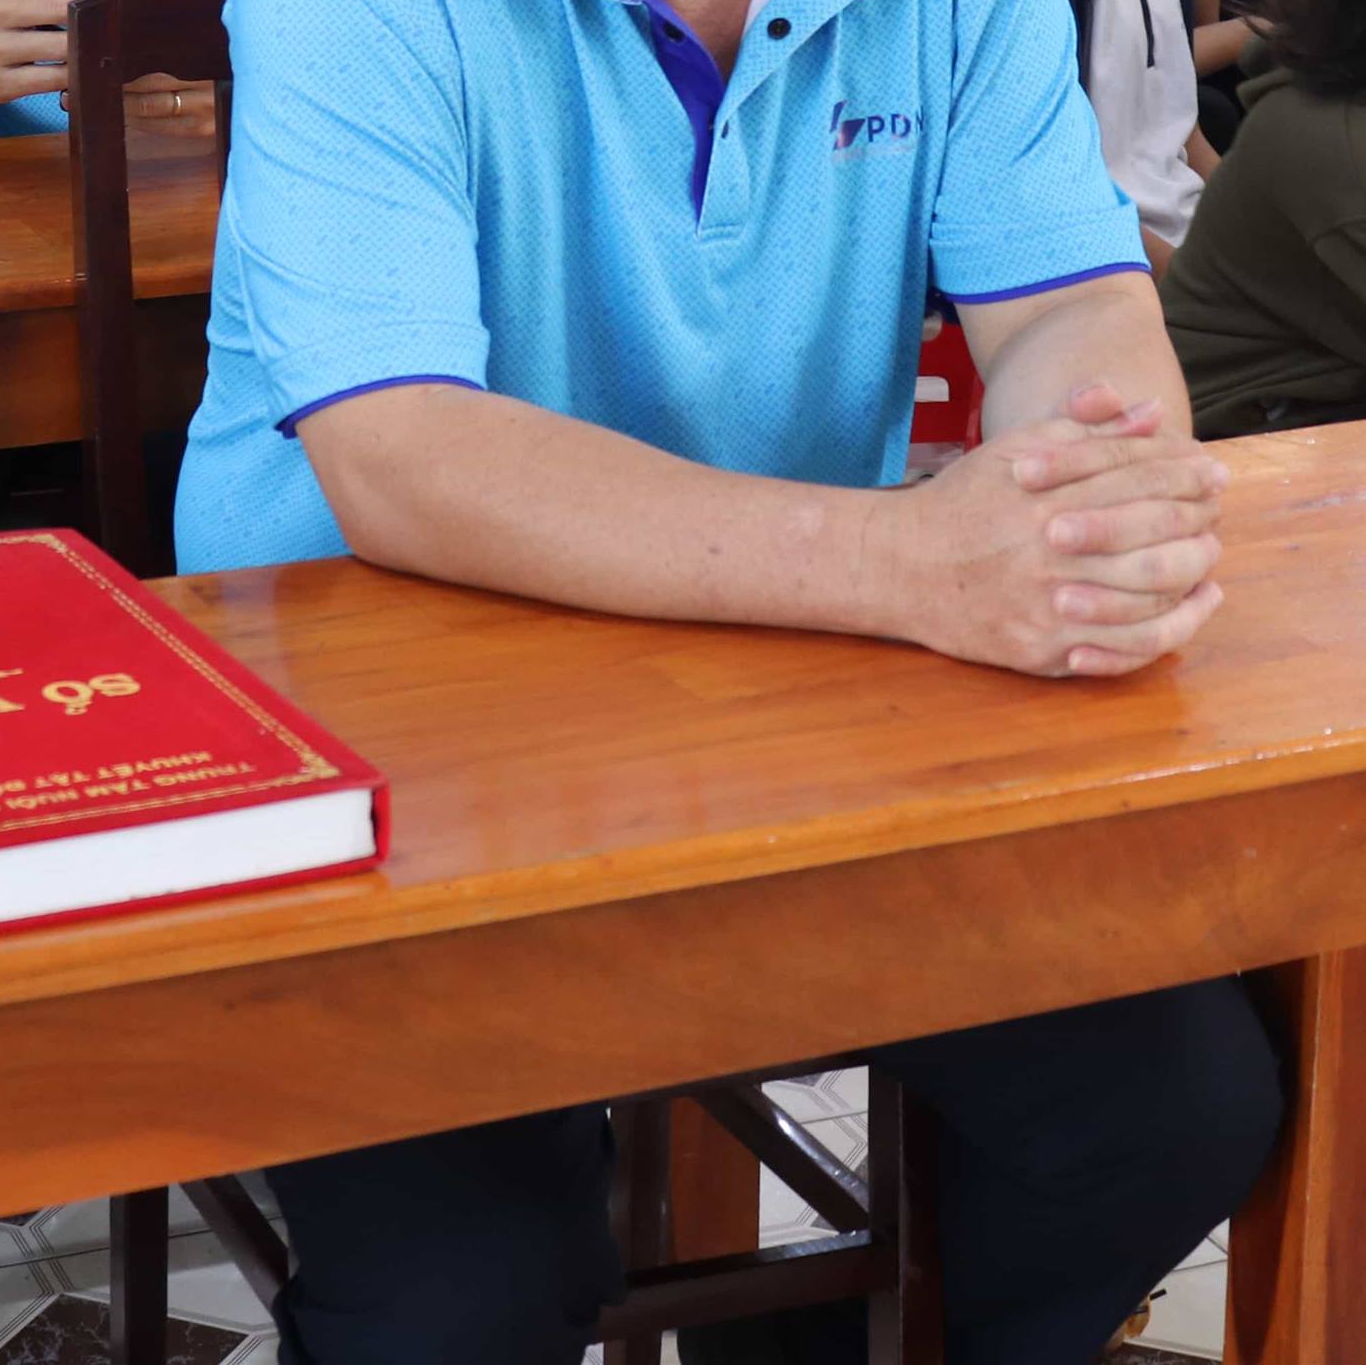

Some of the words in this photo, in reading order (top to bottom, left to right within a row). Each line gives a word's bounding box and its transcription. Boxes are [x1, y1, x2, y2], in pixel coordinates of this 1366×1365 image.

[42, 673, 141, 715] SỔ
[96, 750, 213, 780] KHUYẾT
[153, 762, 258, 787] TRUNG
[35, 769, 92, 789] TẬT
[84, 778, 150, 798] TÂM
[6, 788, 80, 811] NUÔI
